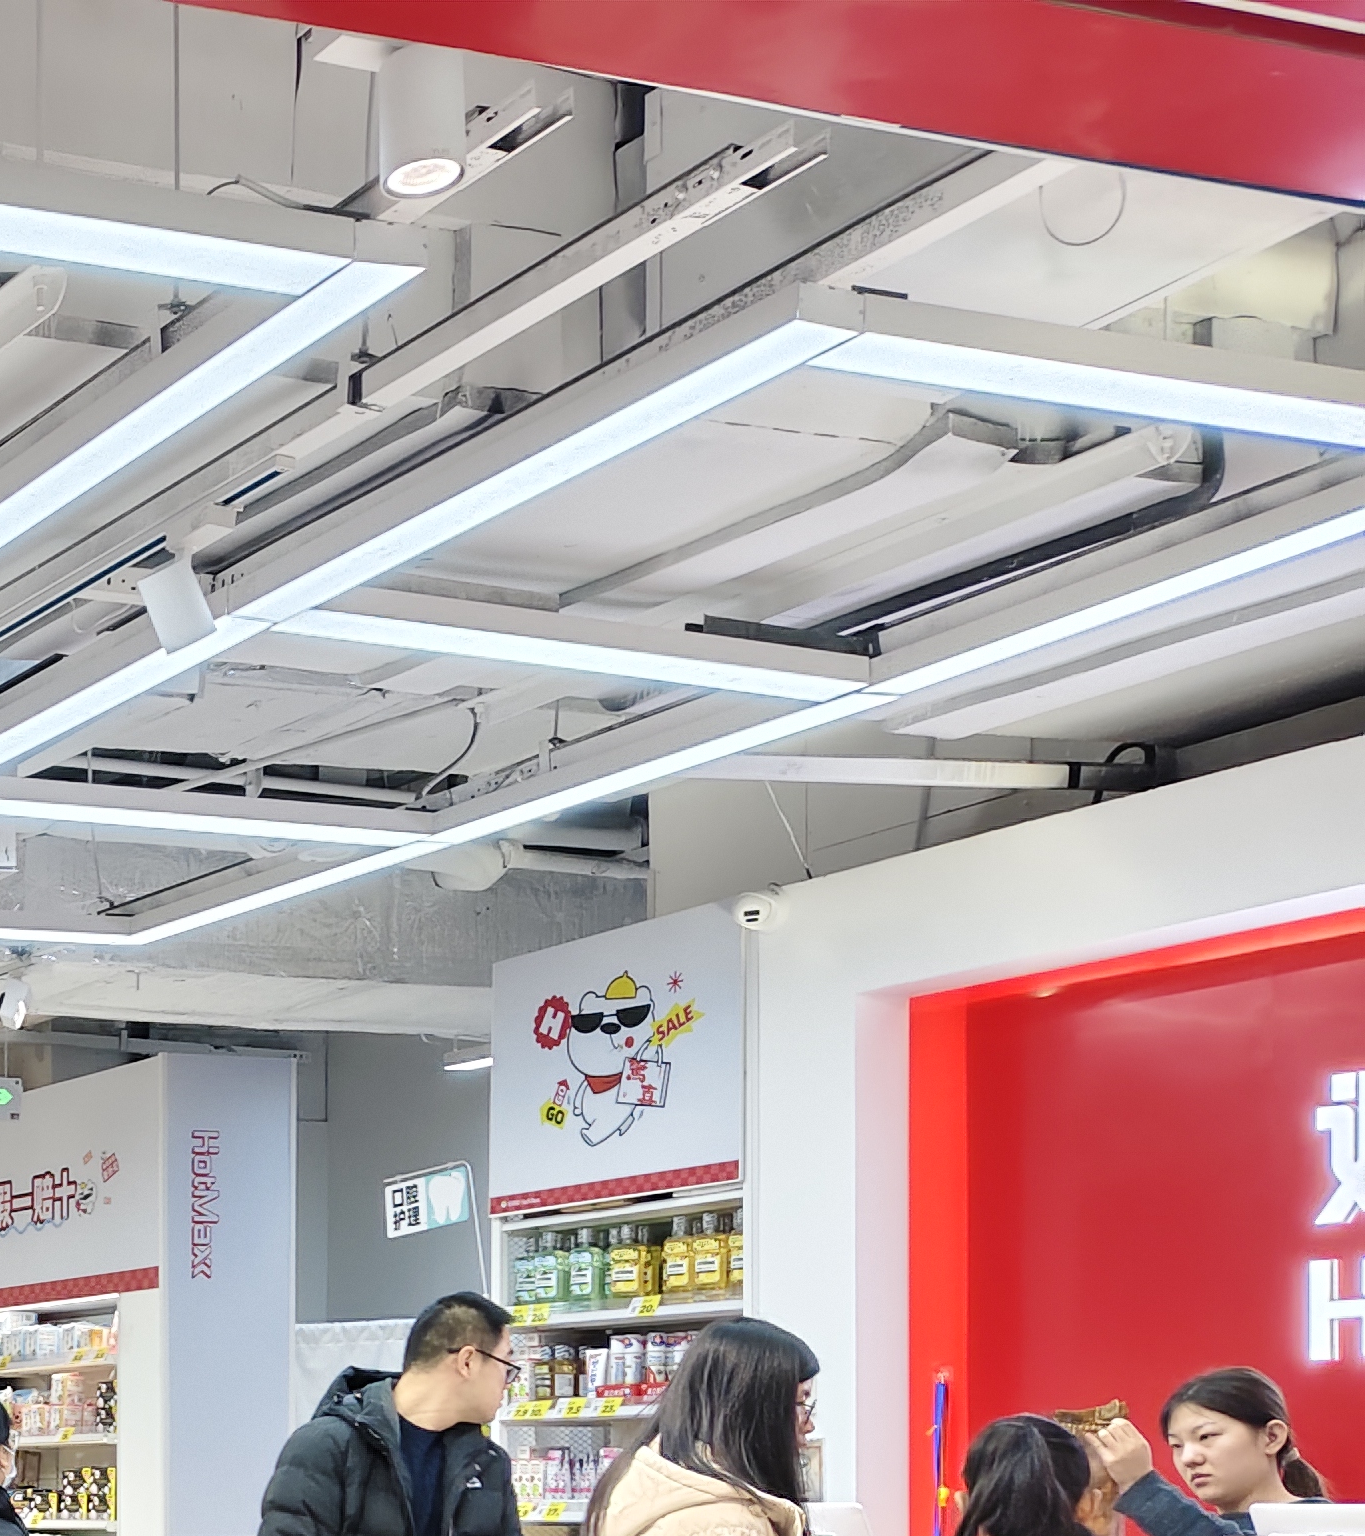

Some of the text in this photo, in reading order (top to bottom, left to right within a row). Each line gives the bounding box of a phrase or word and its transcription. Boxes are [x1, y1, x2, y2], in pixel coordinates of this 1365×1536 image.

[539, 1006, 565, 1041] H
[656, 1004, 694, 1042] SALE
[546, 1106, 565, 1124] GO
